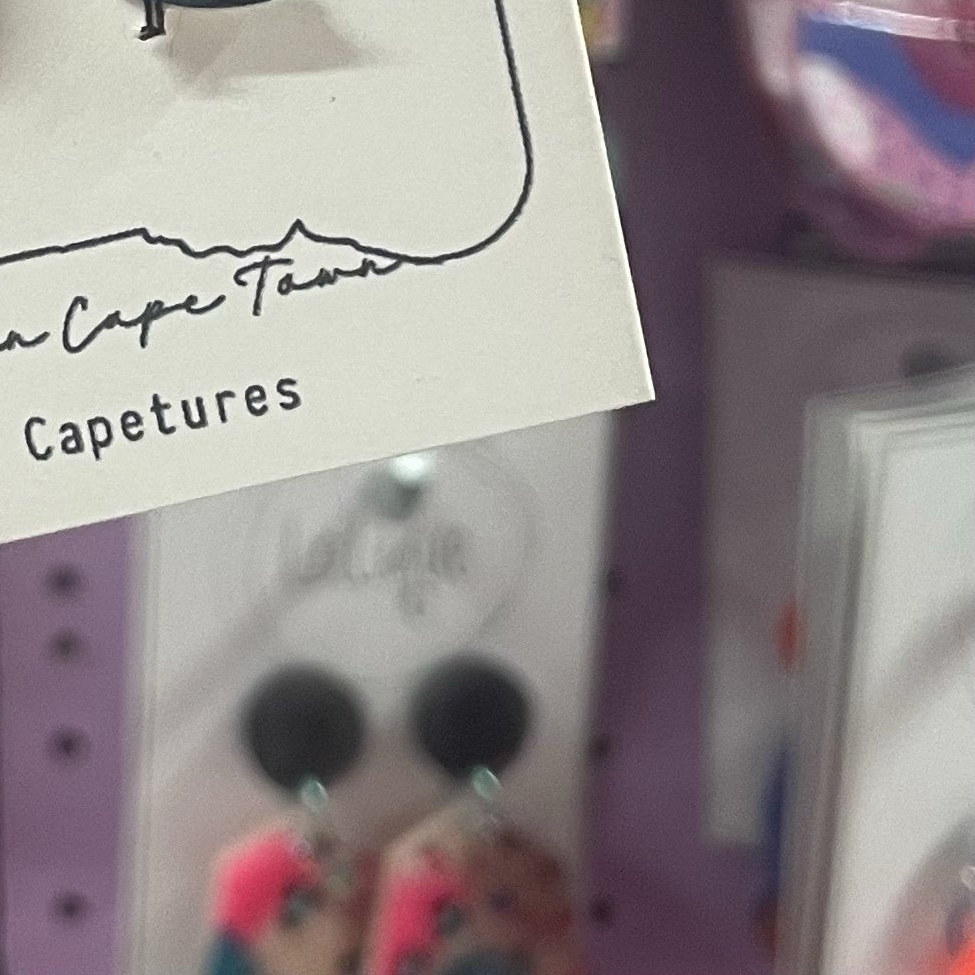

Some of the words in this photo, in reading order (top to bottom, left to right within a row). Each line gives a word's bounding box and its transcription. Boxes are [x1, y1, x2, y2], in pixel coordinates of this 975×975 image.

[61, 295, 226, 353] Cape
[233, 255, 405, 316] Town
[24, 375, 303, 461] Capetures
